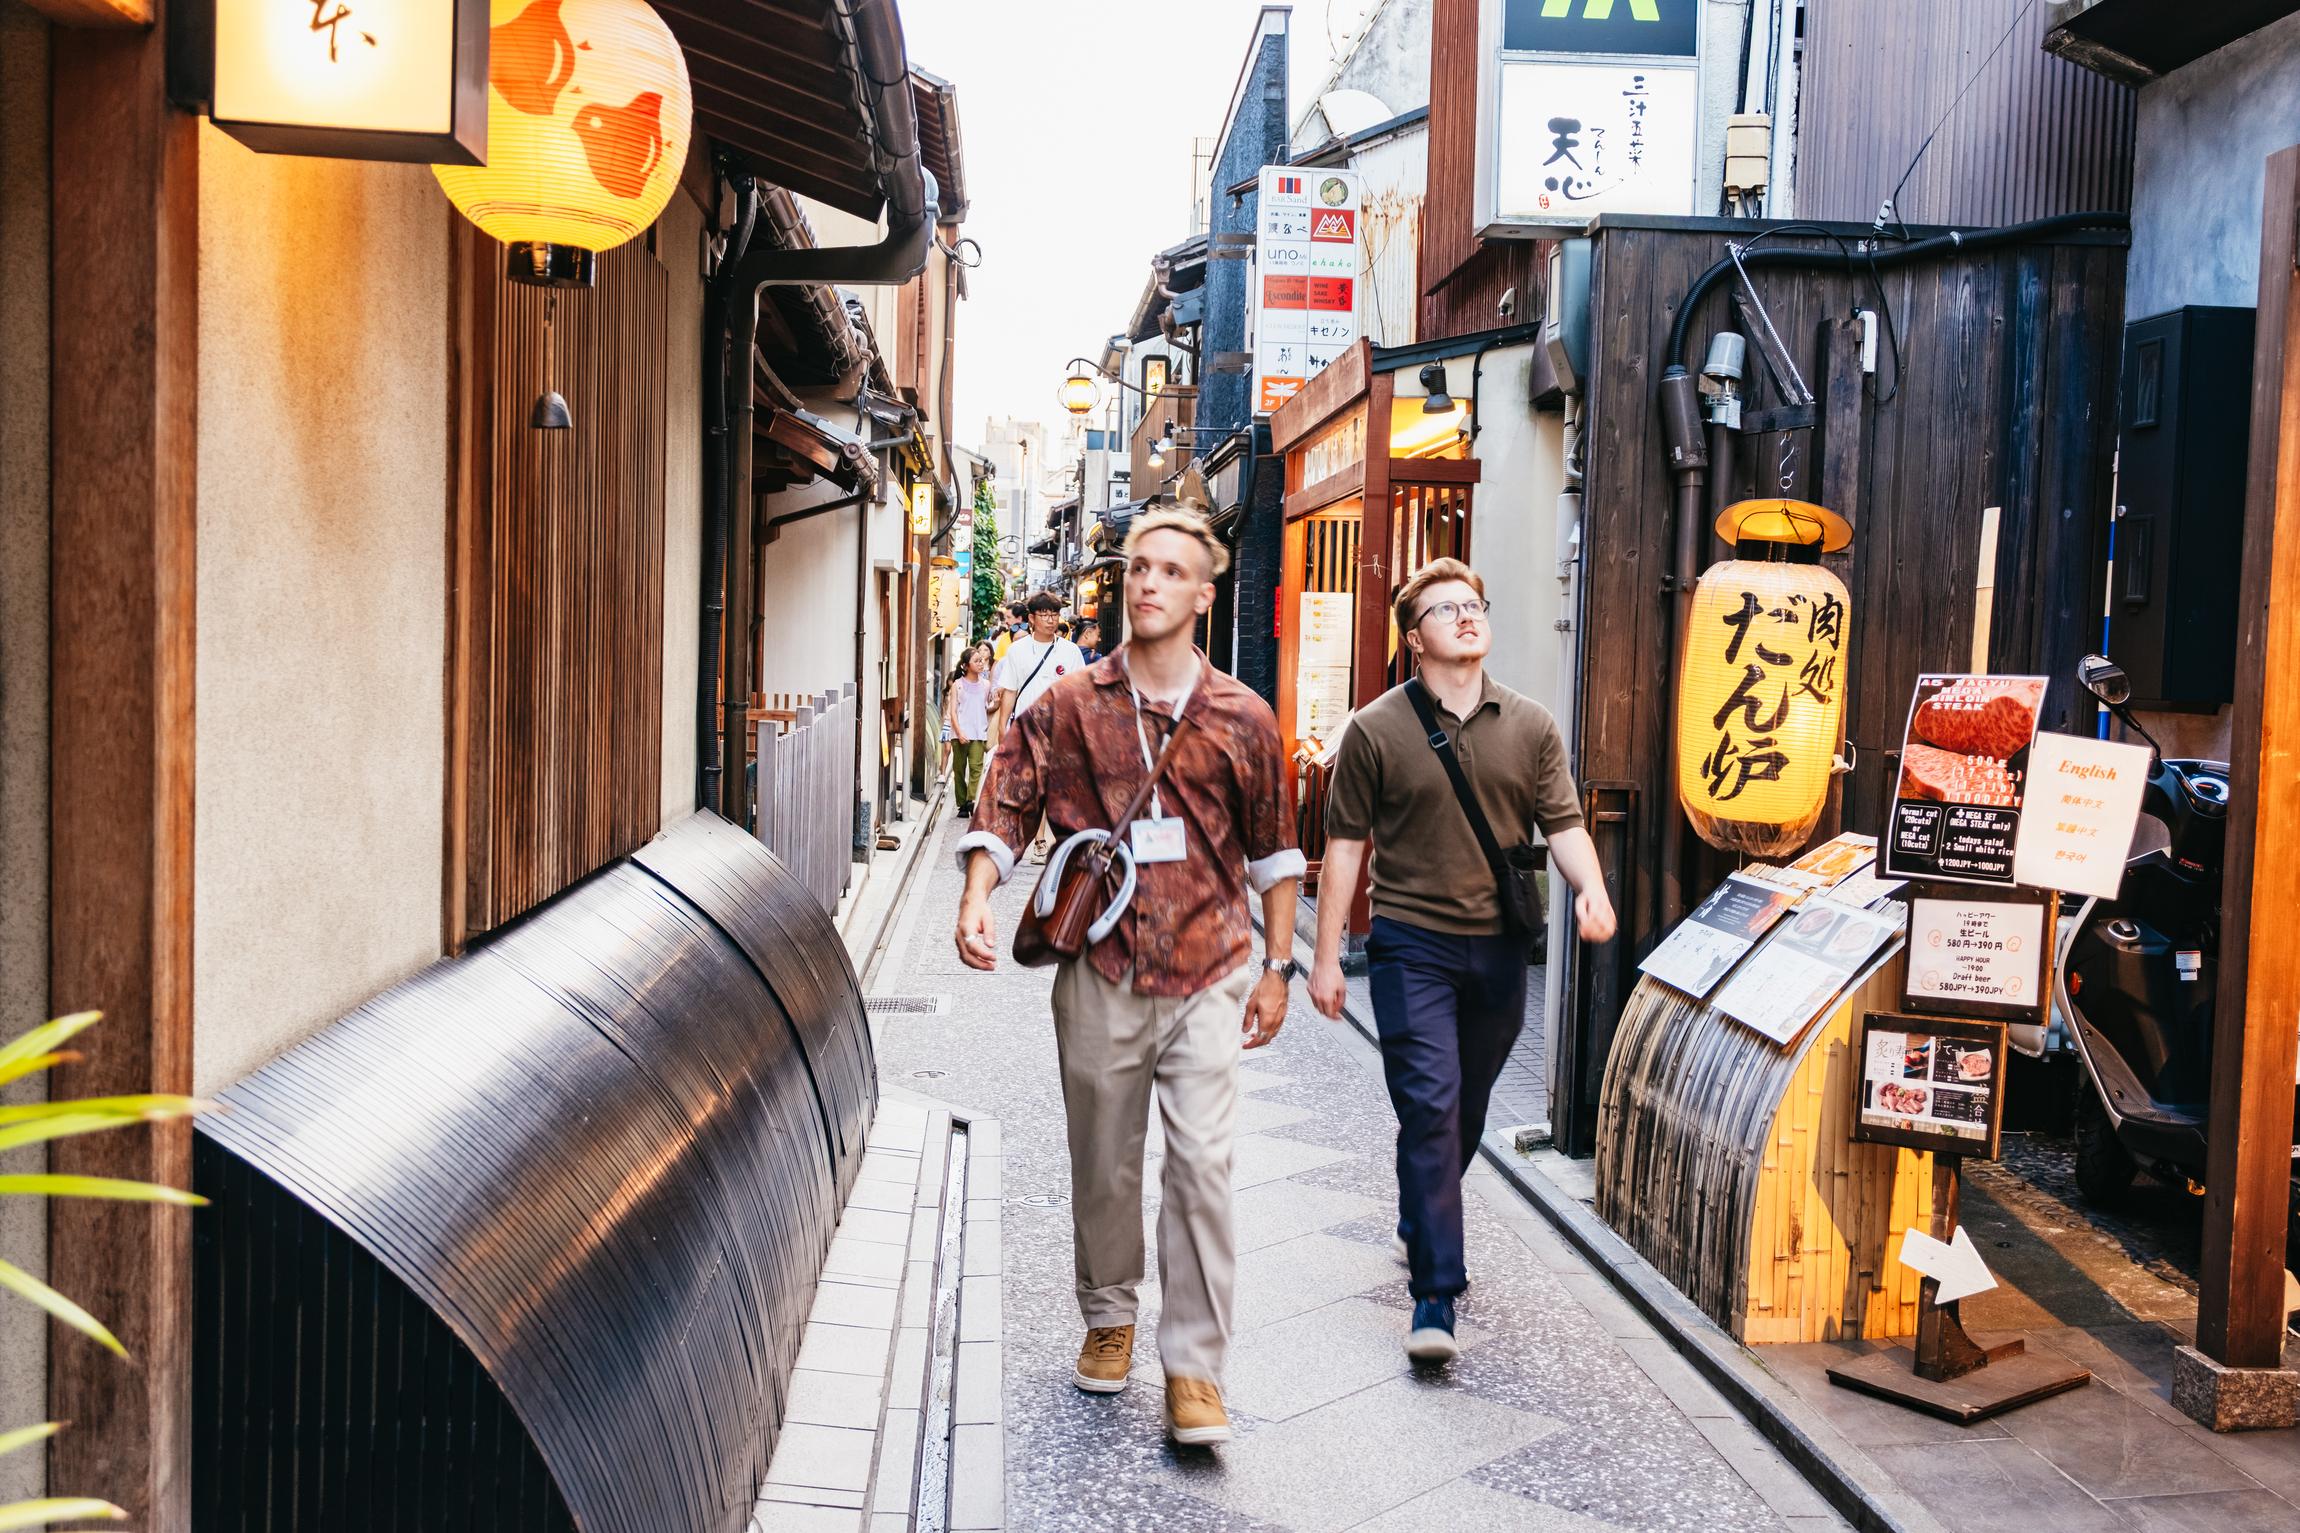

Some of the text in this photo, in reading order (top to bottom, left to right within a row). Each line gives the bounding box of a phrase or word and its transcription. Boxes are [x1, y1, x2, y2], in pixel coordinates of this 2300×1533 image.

[1590, 128, 1605, 176] てんしん
[1542, 117, 1608, 201] 天心
[1310, 325, 1350, 337] キセノン
[1264, 399, 1276, 407] 2F
[1791, 592, 1843, 704] 肉処
[1955, 680, 2011, 688] WAGYU
[1700, 591, 1807, 801] だん炉
[1930, 694, 1991, 703] SIRLOIN
[1932, 702, 1984, 710] STEAK
[2058, 760, 2118, 780] English
[1901, 808, 1938, 818] Normal cut
[1984, 813, 1998, 821] SET
[1904, 816, 1932, 826] (20cuts)
[1970, 820, 1990, 828] STEAK
[1992, 822, 2011, 832] only)
[1900, 832, 1930, 842] MEGA cut
[1901, 840, 1928, 850] (10cuts)
[1984, 838, 2004, 847] salad
[1946, 842, 2014, 856] 2 Small white rice
[1960, 928, 1990, 938] 生ビール
[1952, 972, 1992, 982] Draft beer
